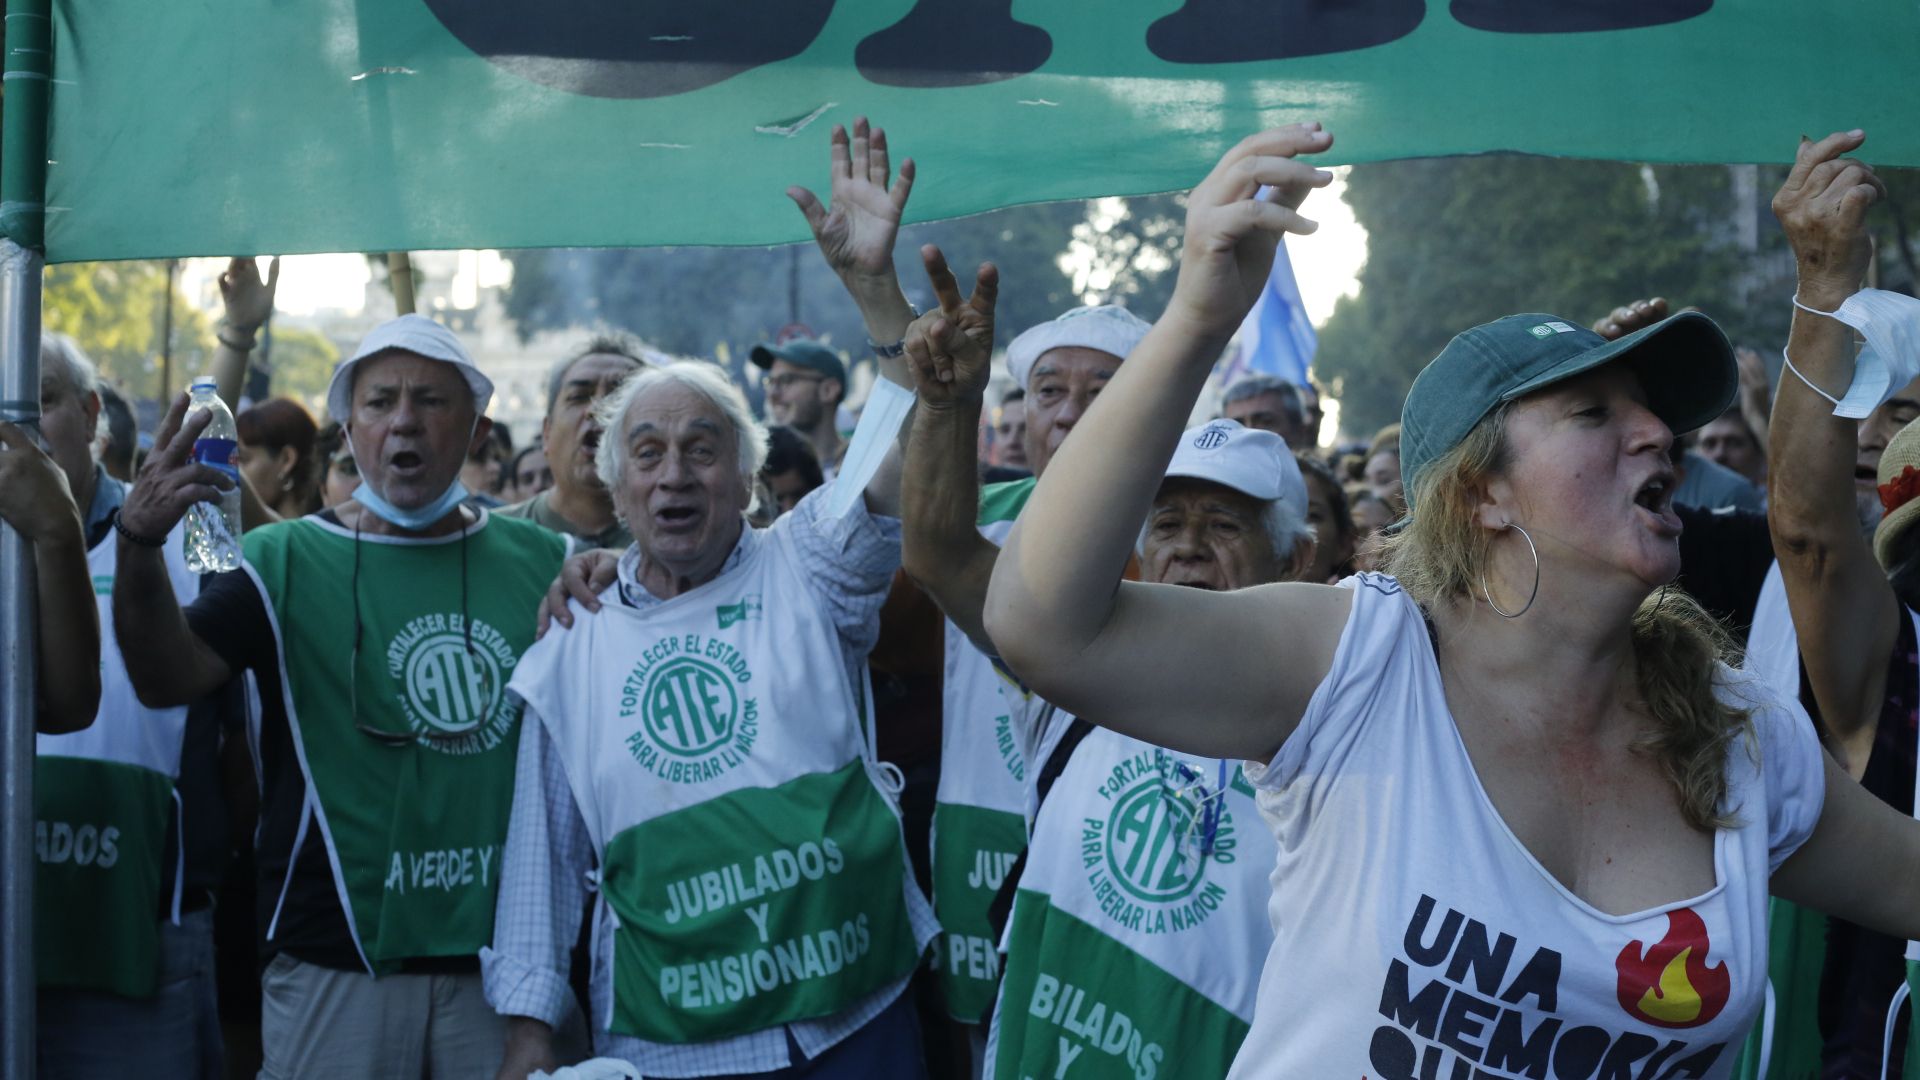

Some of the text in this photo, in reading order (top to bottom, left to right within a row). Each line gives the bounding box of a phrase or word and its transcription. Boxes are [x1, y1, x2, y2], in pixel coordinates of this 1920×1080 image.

[470, 619, 516, 668] ESTADO
[620, 634, 752, 717] FORTALECER EL ESTADO
[652, 665, 727, 748] ATE
[995, 715, 1015, 759] PARA
[625, 731, 659, 772] PARA
[657, 756, 725, 784] LIBERAR
[410, 848, 474, 892] VERDE
[478, 845, 493, 888] Y
[664, 837, 844, 924] JUBILADOS
[1082, 818, 1227, 934] PARA LIBERAR LA NACION
[660, 912, 870, 1008] PENSIONADOS
[744, 902, 769, 943] Y
[1403, 893, 1562, 1013] UNA
[1029, 973, 1163, 1080] BILADOS
[1054, 1036, 1083, 1080] Y
[1369, 1026, 1515, 1080] QU
[1378, 957, 1728, 1080] MEMORIA
